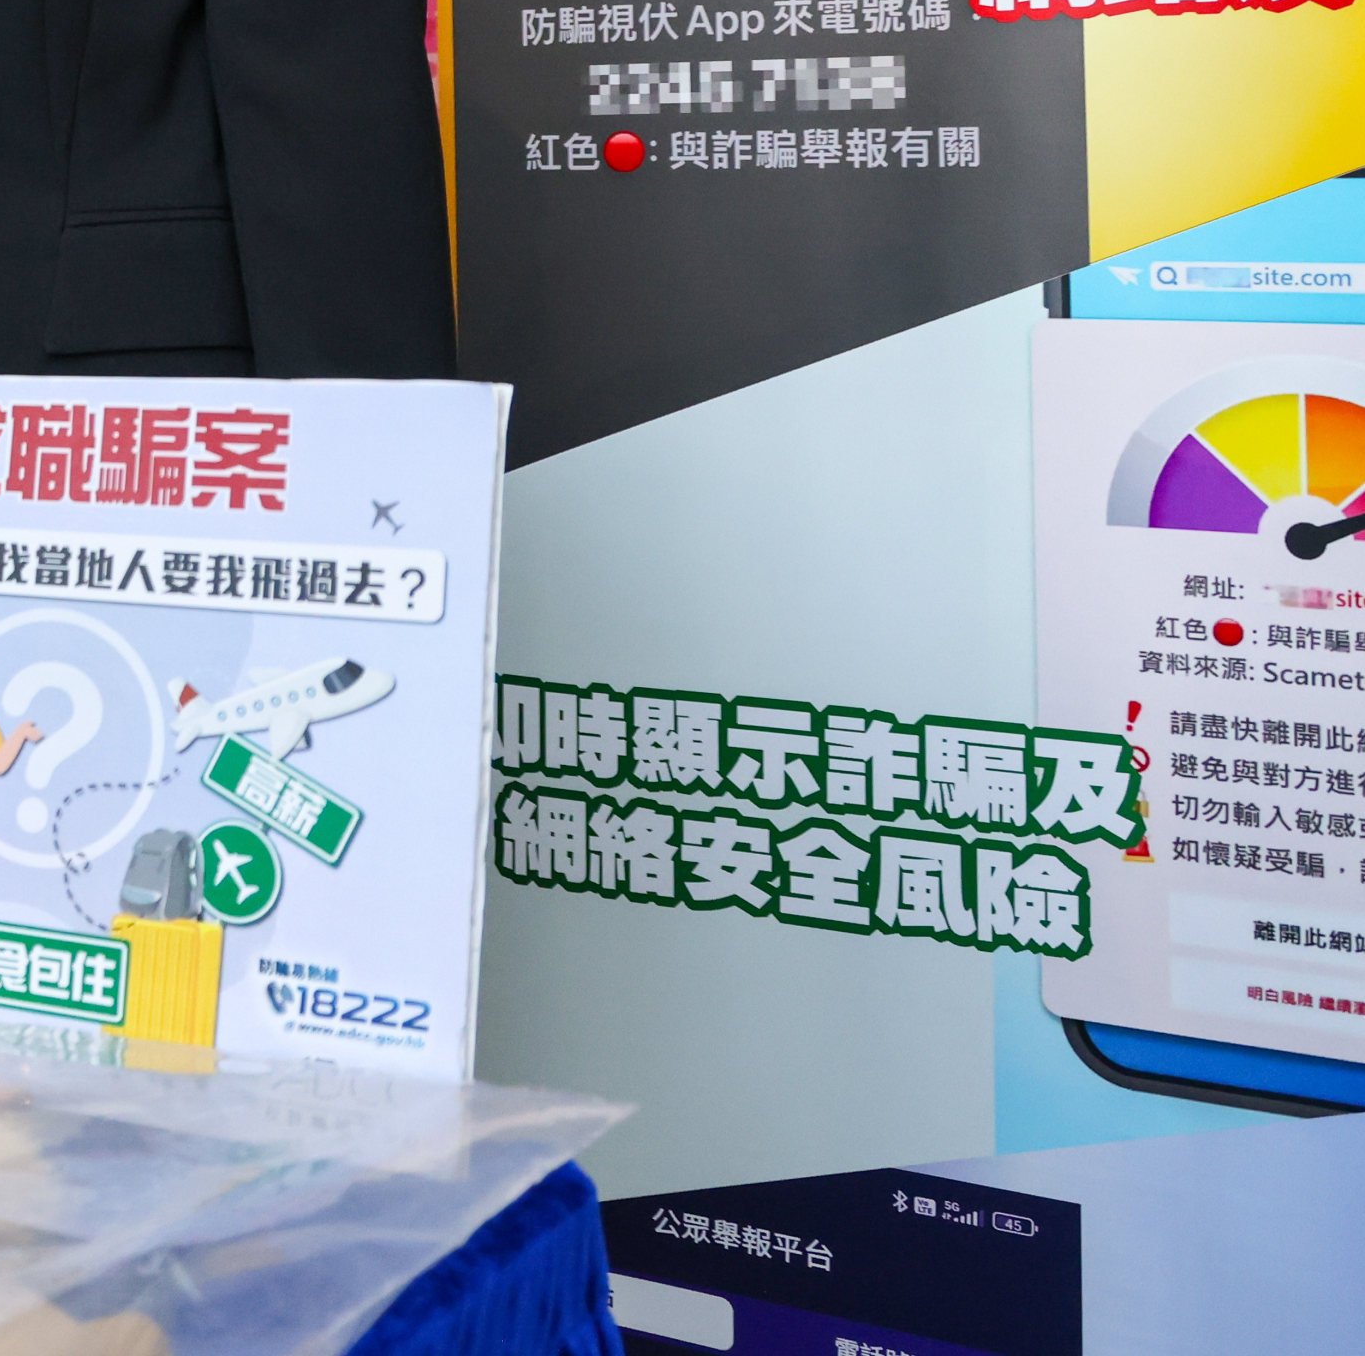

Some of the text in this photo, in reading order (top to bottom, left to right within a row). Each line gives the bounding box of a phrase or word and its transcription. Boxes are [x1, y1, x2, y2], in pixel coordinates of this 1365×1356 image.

[1336, 589, 1365, 609] sit
[1155, 615, 1209, 642] 紅色
[235, 754, 328, 839] 高薪
[500, 788, 1085, 954] 網絡安全風險
[1172, 836, 1365, 884] 如懷疑受騙，
[297, 985, 433, 1032] 18222
[944, 1200, 961, 1213] 5G
[1004, 1218, 1023, 1232] 45
[651, 1207, 835, 1273] 公眾舉報平台
